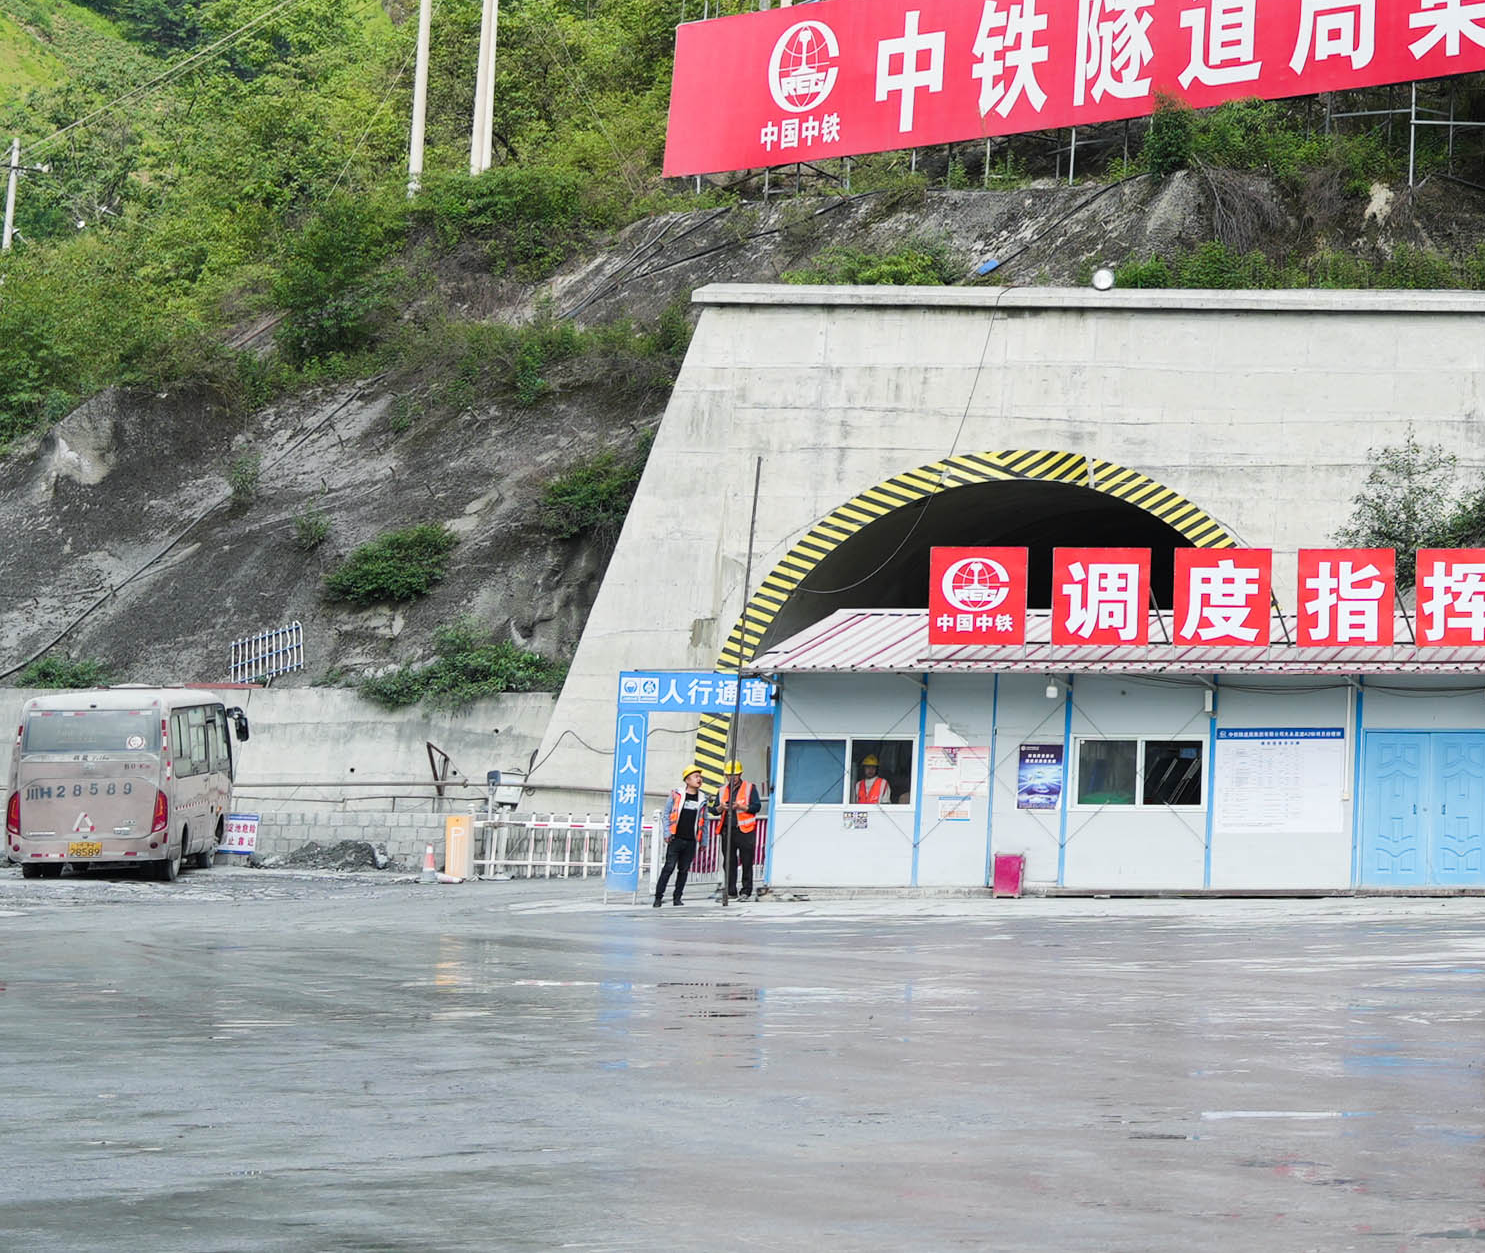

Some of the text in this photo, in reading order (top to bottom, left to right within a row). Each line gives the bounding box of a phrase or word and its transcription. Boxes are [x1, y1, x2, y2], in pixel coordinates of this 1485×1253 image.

[760, 112, 841, 152] 中国中铁
[936, 613, 1013, 632] 中国中铁
[659, 678, 769, 707] 人行通道
[26, 782, 133, 801] 川H28589
[614, 724, 640, 864] 人人讲安全
